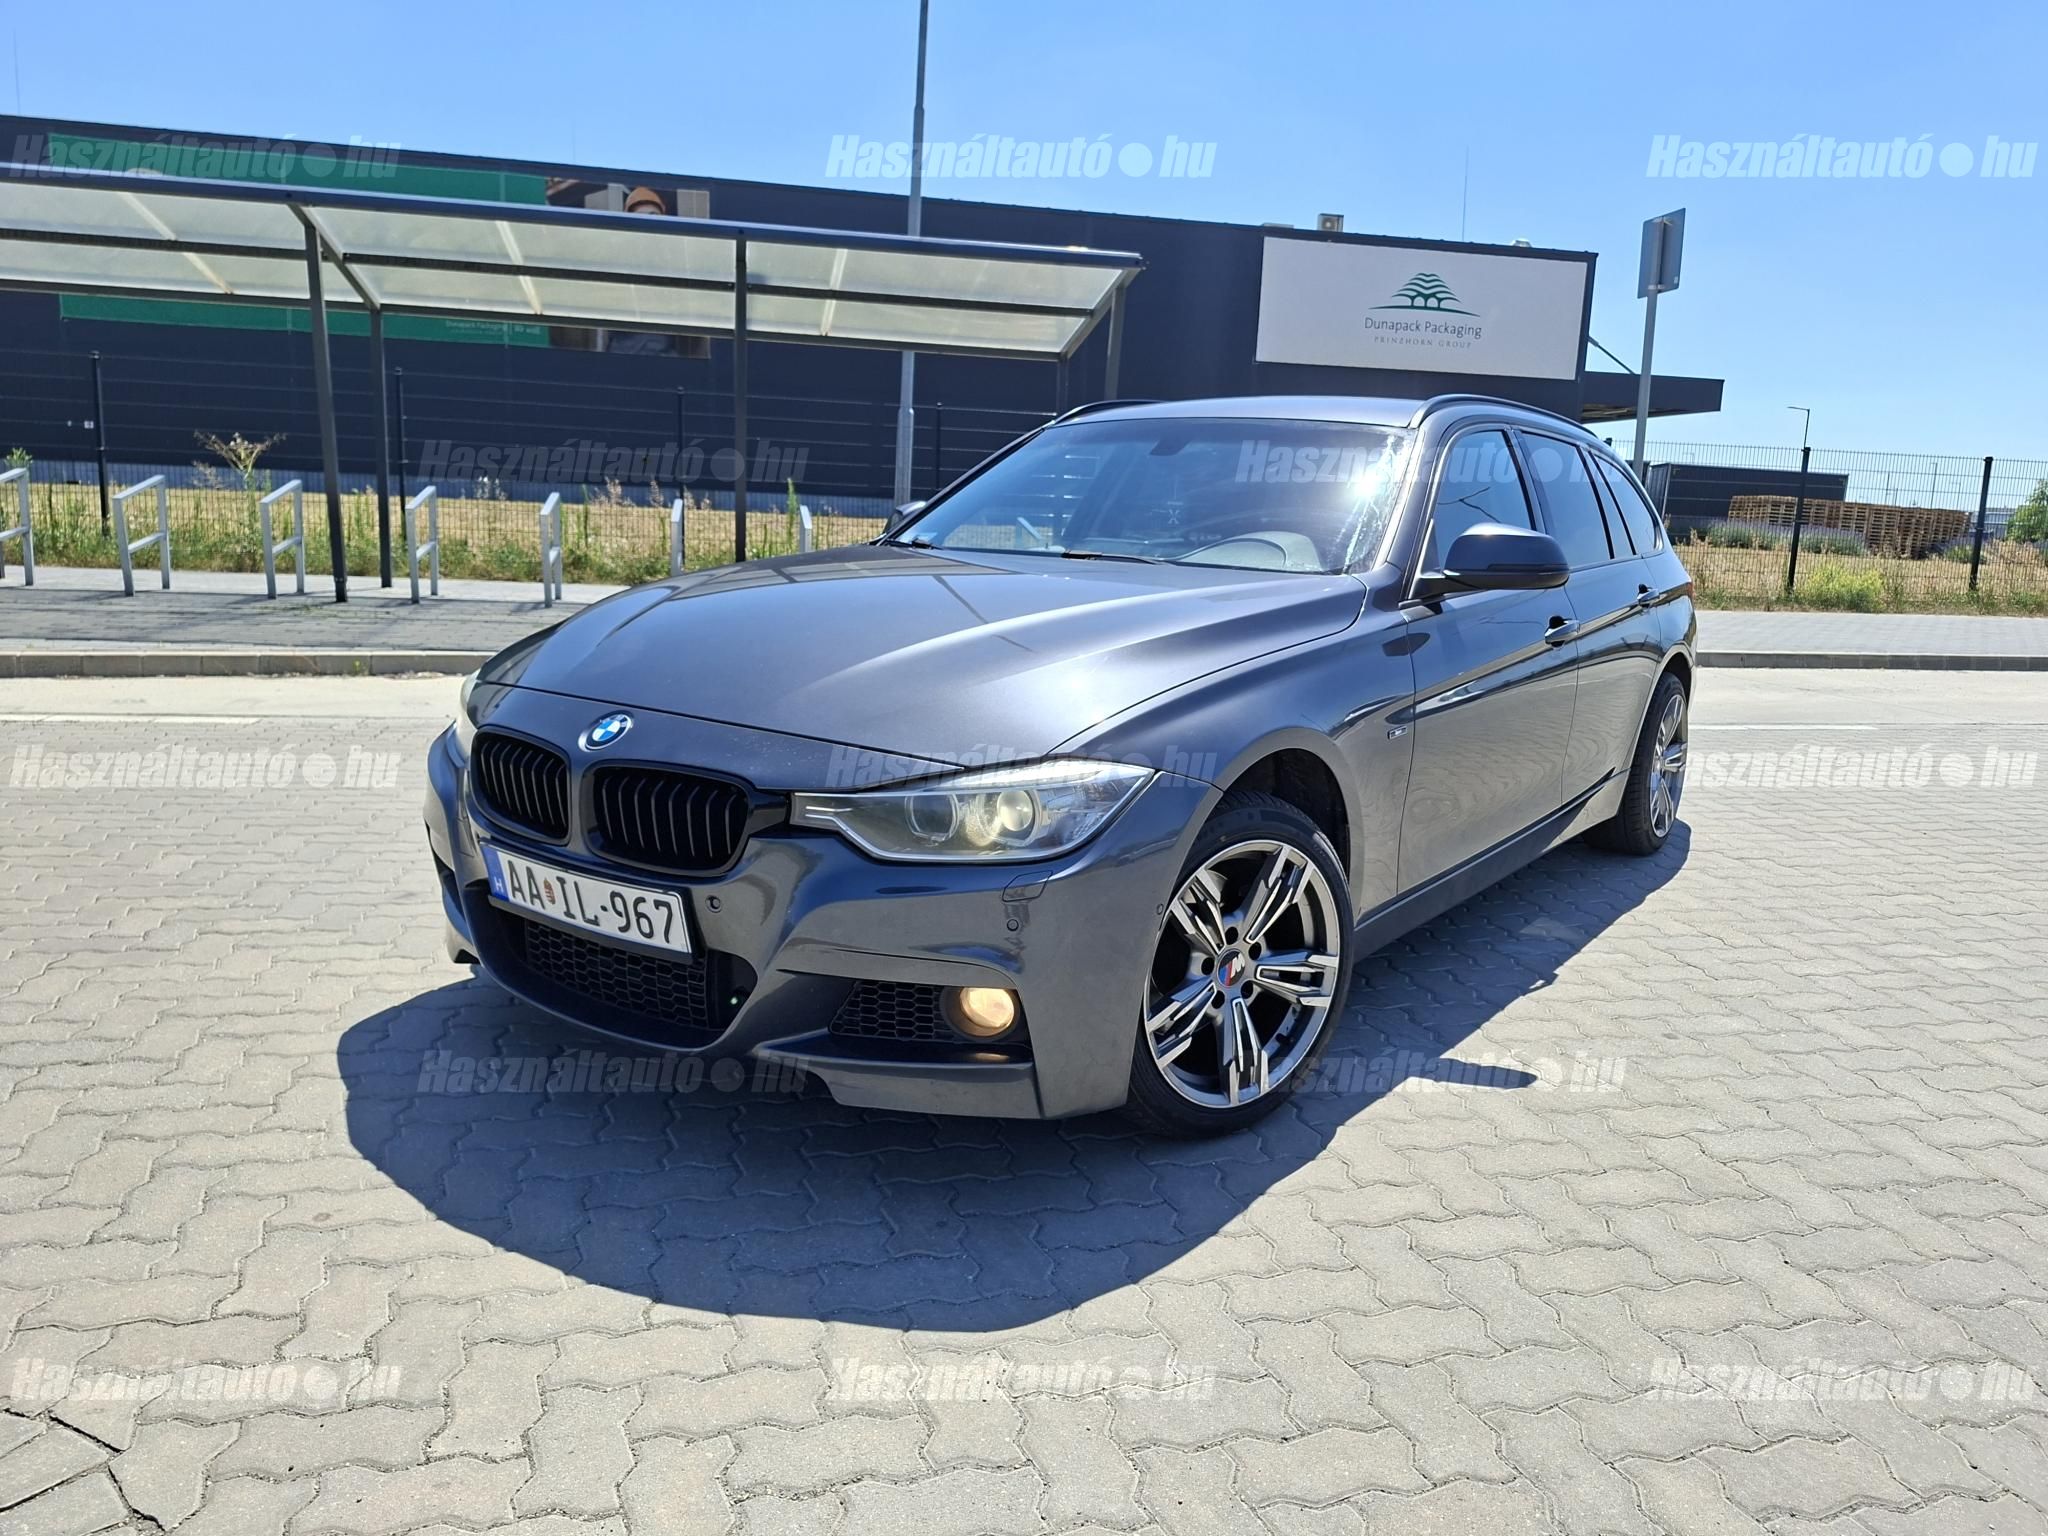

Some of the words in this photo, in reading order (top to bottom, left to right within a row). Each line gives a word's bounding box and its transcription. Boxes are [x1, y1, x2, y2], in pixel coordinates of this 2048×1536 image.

[1364, 317, 1421, 333] Dunapack
[1425, 321, 1482, 339] Packaging
[1438, 340, 1472, 349] GROUP
